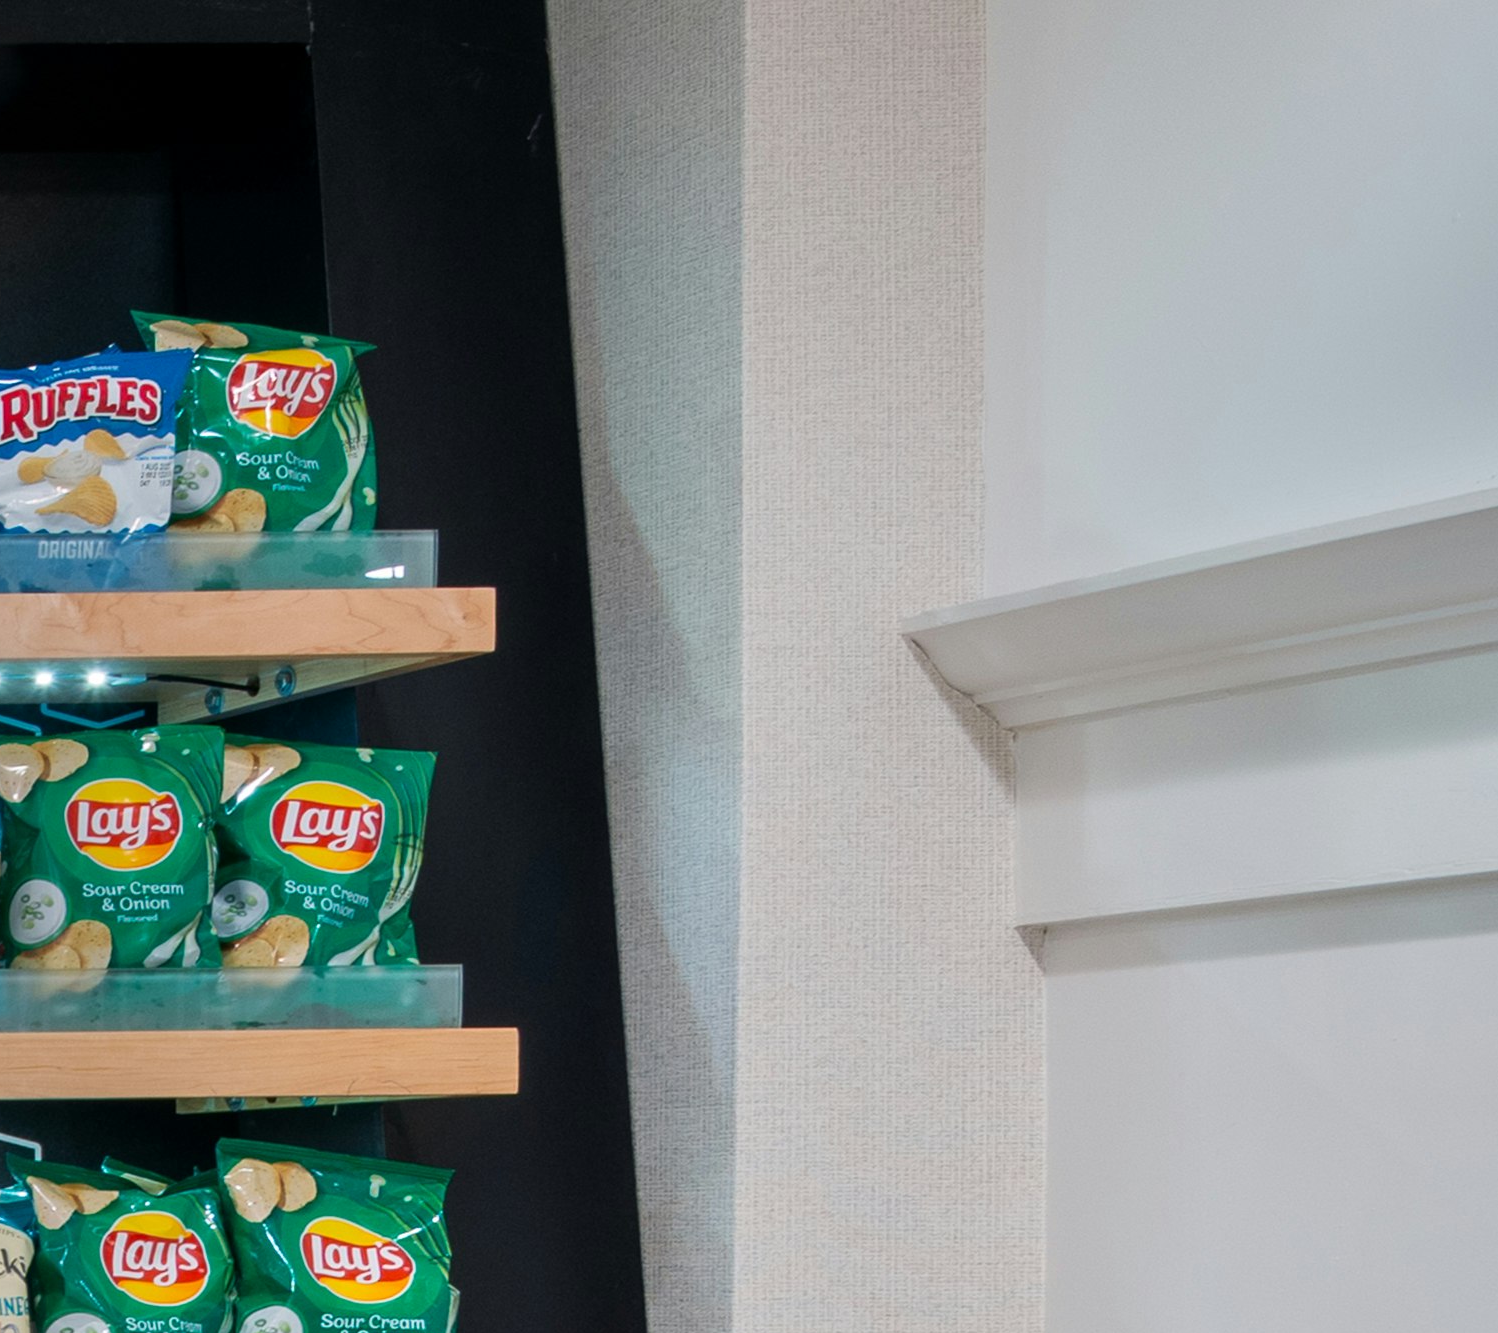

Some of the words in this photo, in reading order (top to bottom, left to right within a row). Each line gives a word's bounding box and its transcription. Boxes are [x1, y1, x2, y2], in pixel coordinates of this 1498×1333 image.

[230, 352, 333, 418] Lay's
[238, 451, 276, 468] Sour
[77, 798, 173, 850] Lay's
[279, 801, 380, 853] Lay's
[83, 881, 126, 897] Sour
[130, 881, 184, 896] Cream
[285, 879, 326, 895] Sour
[119, 895, 171, 911] Onion
[112, 1236, 199, 1286] Lay's
[312, 1235, 404, 1284] Lay's
[126, 1318, 170, 1332] Sour
[321, 1314, 364, 1330] Sour
[368, 1315, 426, 1330] Cream
